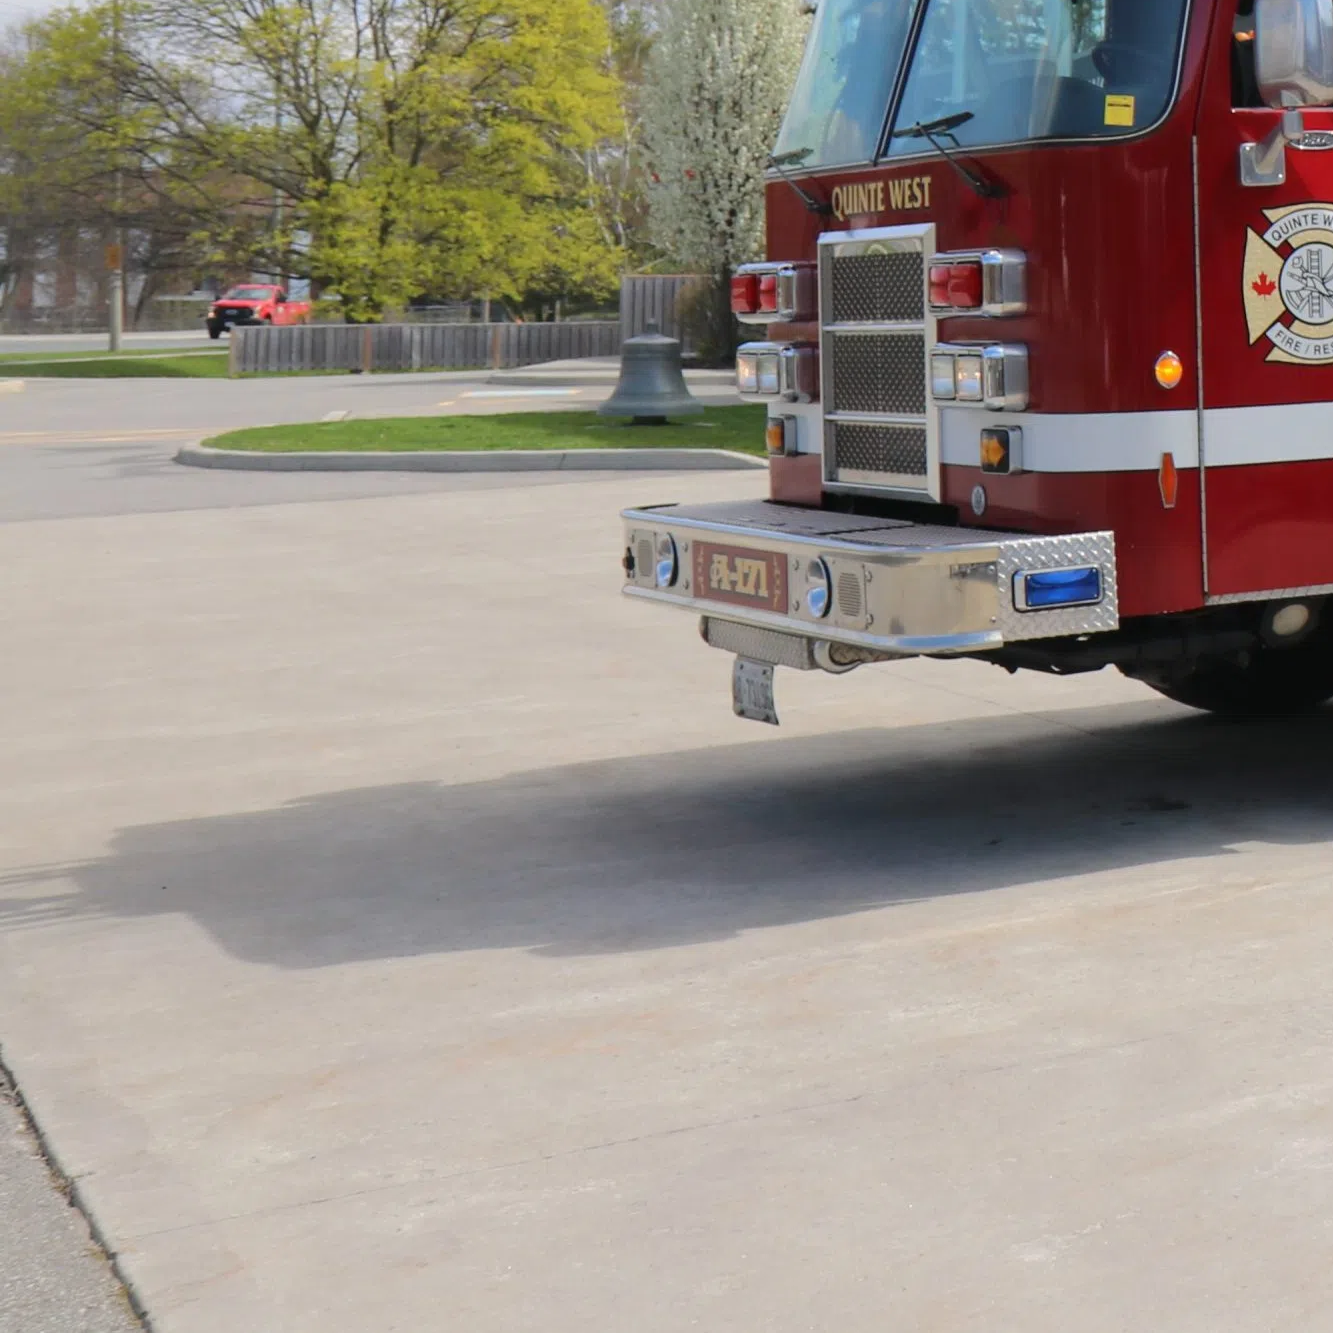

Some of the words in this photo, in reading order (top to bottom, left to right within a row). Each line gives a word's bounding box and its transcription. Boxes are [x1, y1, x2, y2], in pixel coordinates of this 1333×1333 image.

[832, 182, 885, 222] QUINTE
[889, 176, 931, 210] WEST
[1271, 213, 1318, 241] QUINTE
[1275, 330, 1302, 353] FIRE
[710, 553, 769, 598] A-171
